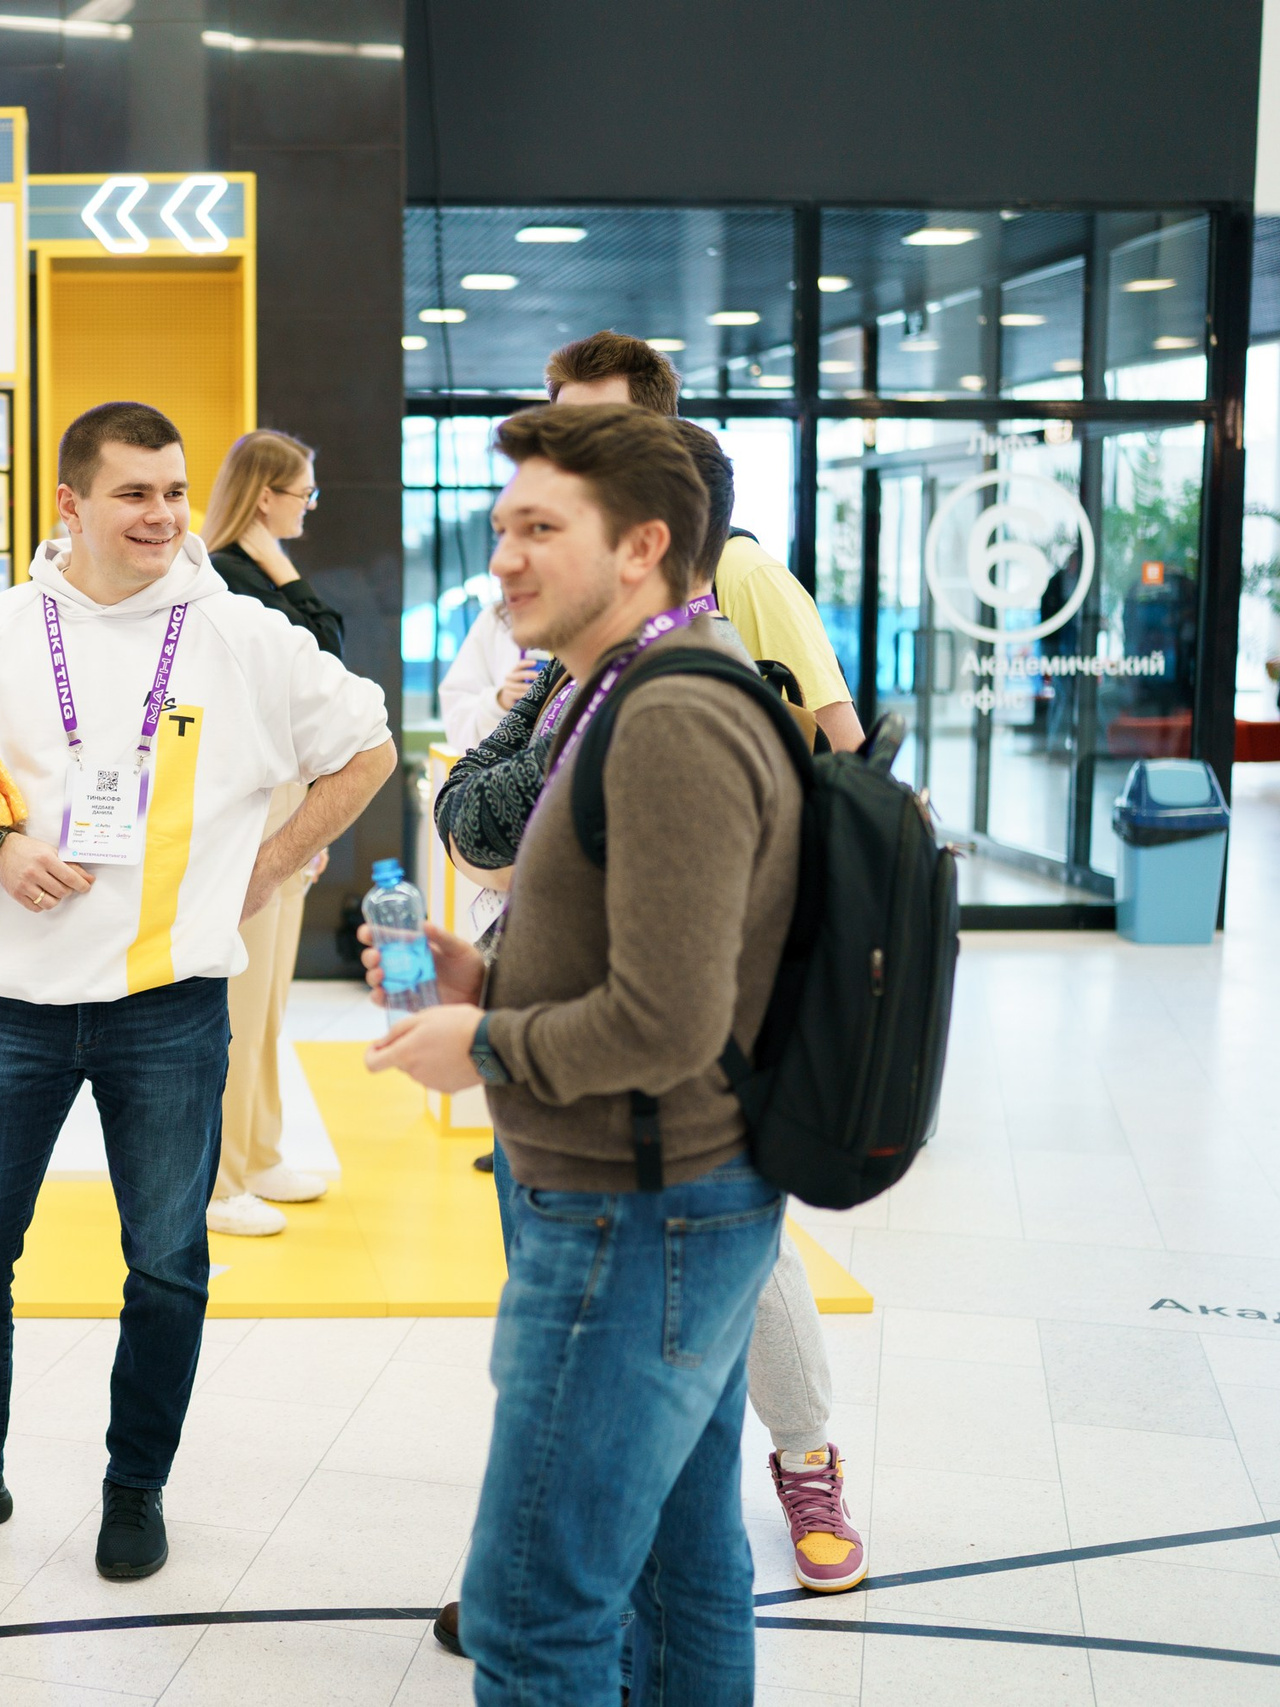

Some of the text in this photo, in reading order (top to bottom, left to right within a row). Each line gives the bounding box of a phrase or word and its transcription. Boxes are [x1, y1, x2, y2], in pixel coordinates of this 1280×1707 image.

[968, 503, 1050, 608] 6
[146, 658, 171, 725] MATH
[960, 650, 1166, 680] Академический
